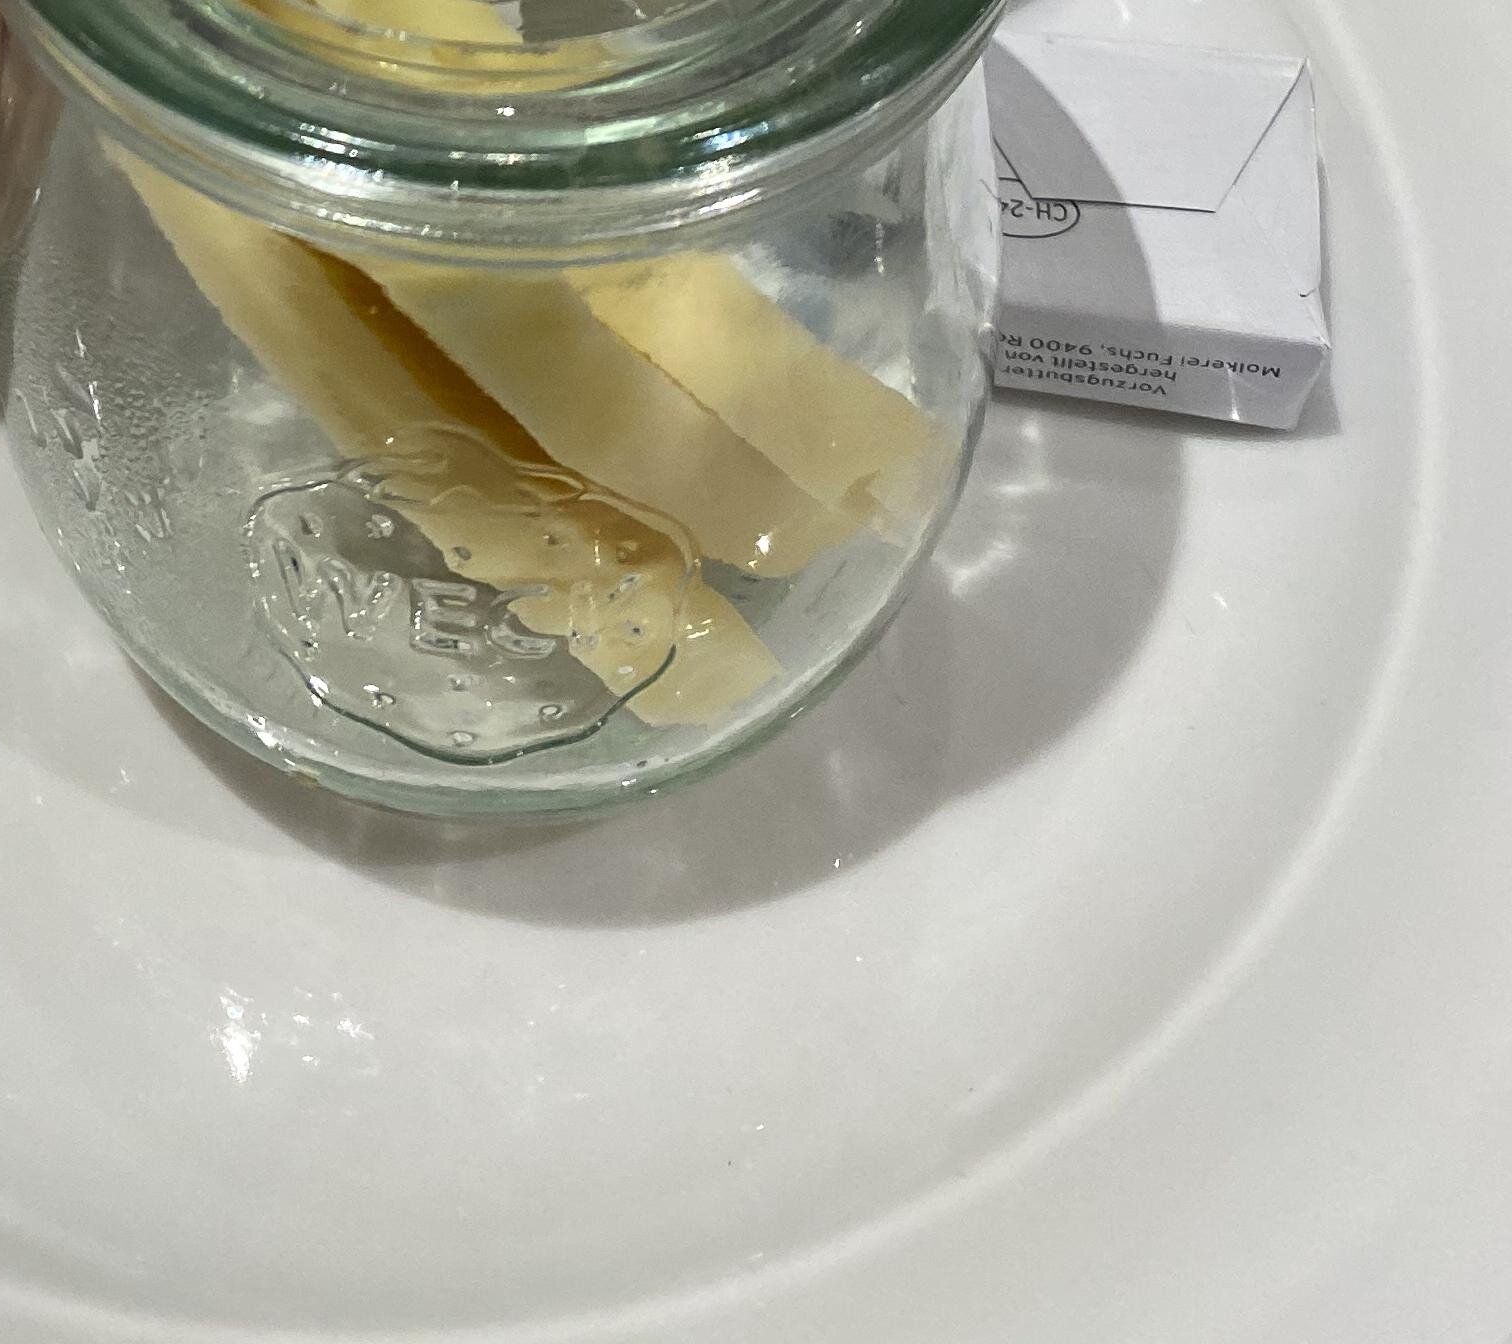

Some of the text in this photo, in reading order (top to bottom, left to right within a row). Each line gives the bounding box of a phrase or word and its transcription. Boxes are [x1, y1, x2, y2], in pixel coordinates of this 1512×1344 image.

[1028, 336, 1094, 357] 9400
[1100, 342, 1173, 367] Fuchs,
[1004, 348, 1178, 382] hergestellt von
[1180, 356, 1281, 379] Molkerei
[999, 363, 1168, 397] Vorzugsbutter
[266, 536, 641, 662] WECK
